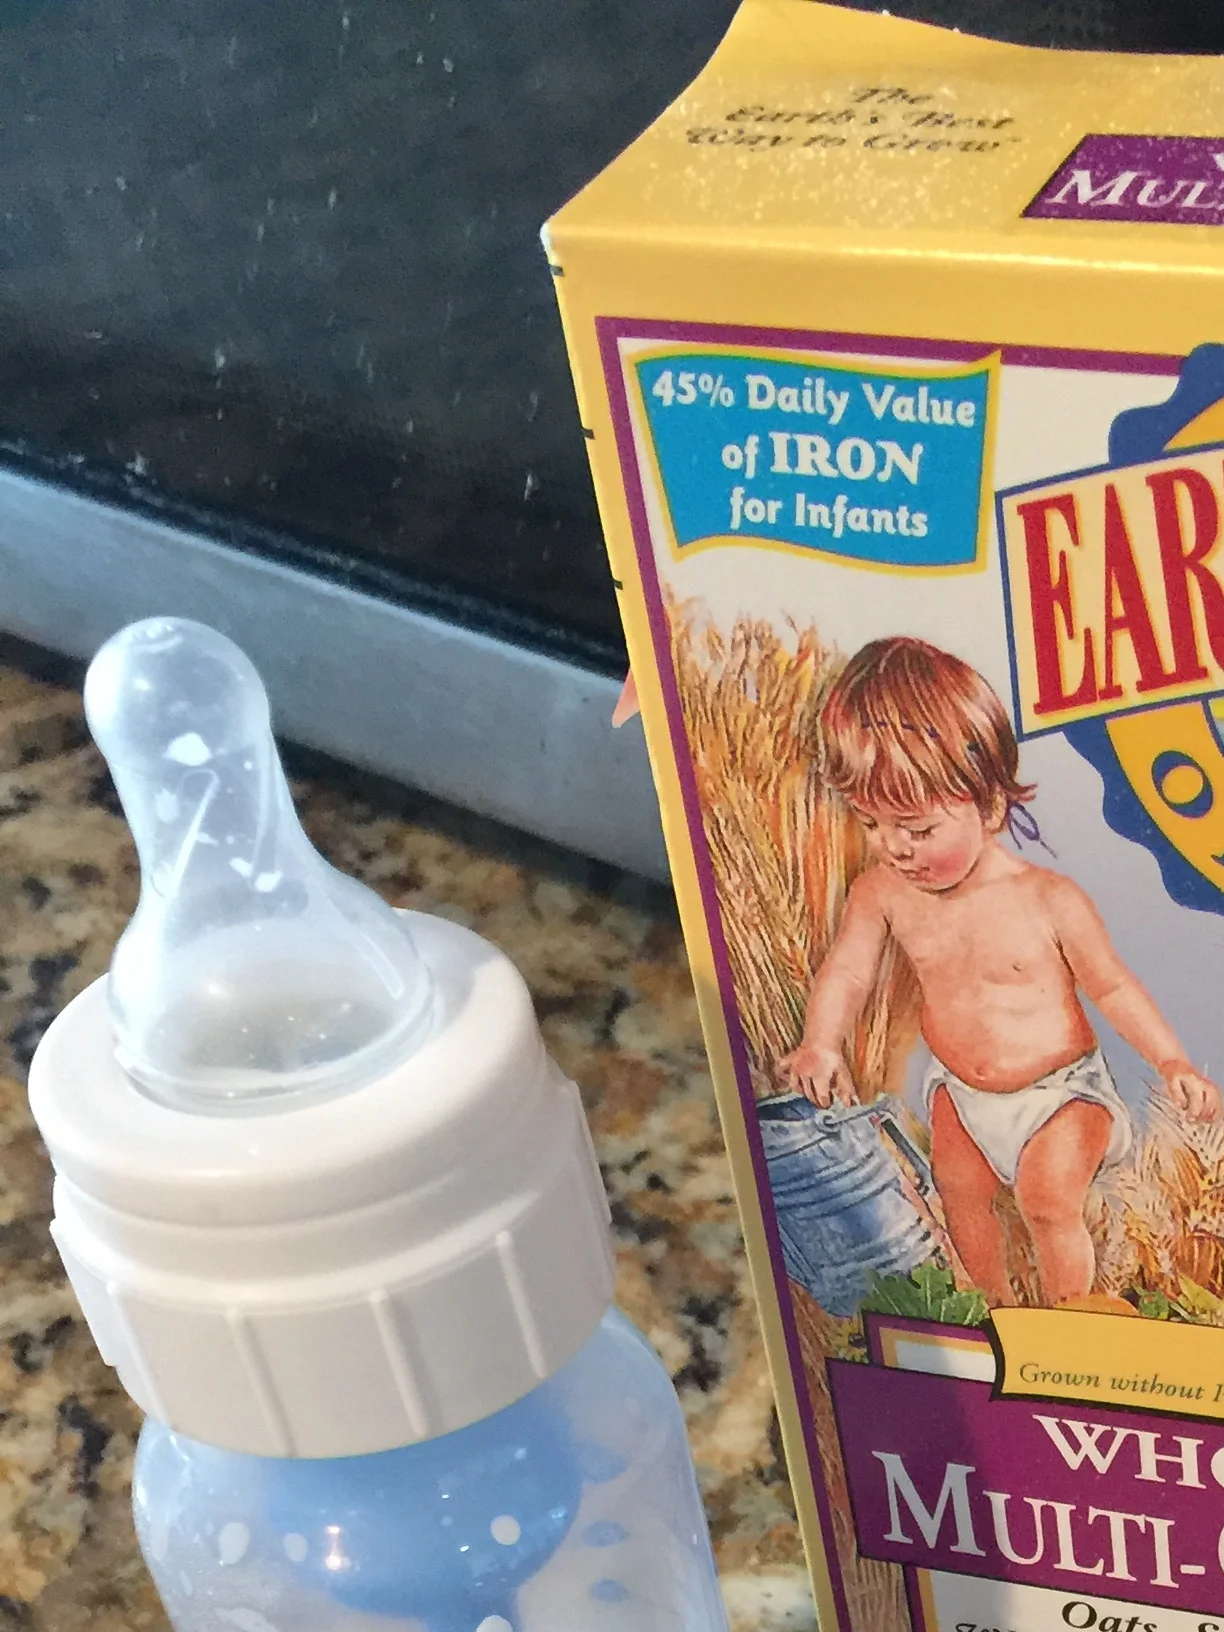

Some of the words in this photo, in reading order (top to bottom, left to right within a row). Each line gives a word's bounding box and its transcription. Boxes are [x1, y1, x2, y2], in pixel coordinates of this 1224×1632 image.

[651, 370, 735, 409] 45%
[745, 374, 850, 425] Daily
[862, 382, 976, 428] Value
[721, 435, 760, 479] of
[769, 432, 924, 485] IRON
[729, 486, 783, 531] for
[794, 494, 928, 538] Infants
[1018, 1363, 1100, 1389] Grown
[1110, 1373, 1204, 1401] without
